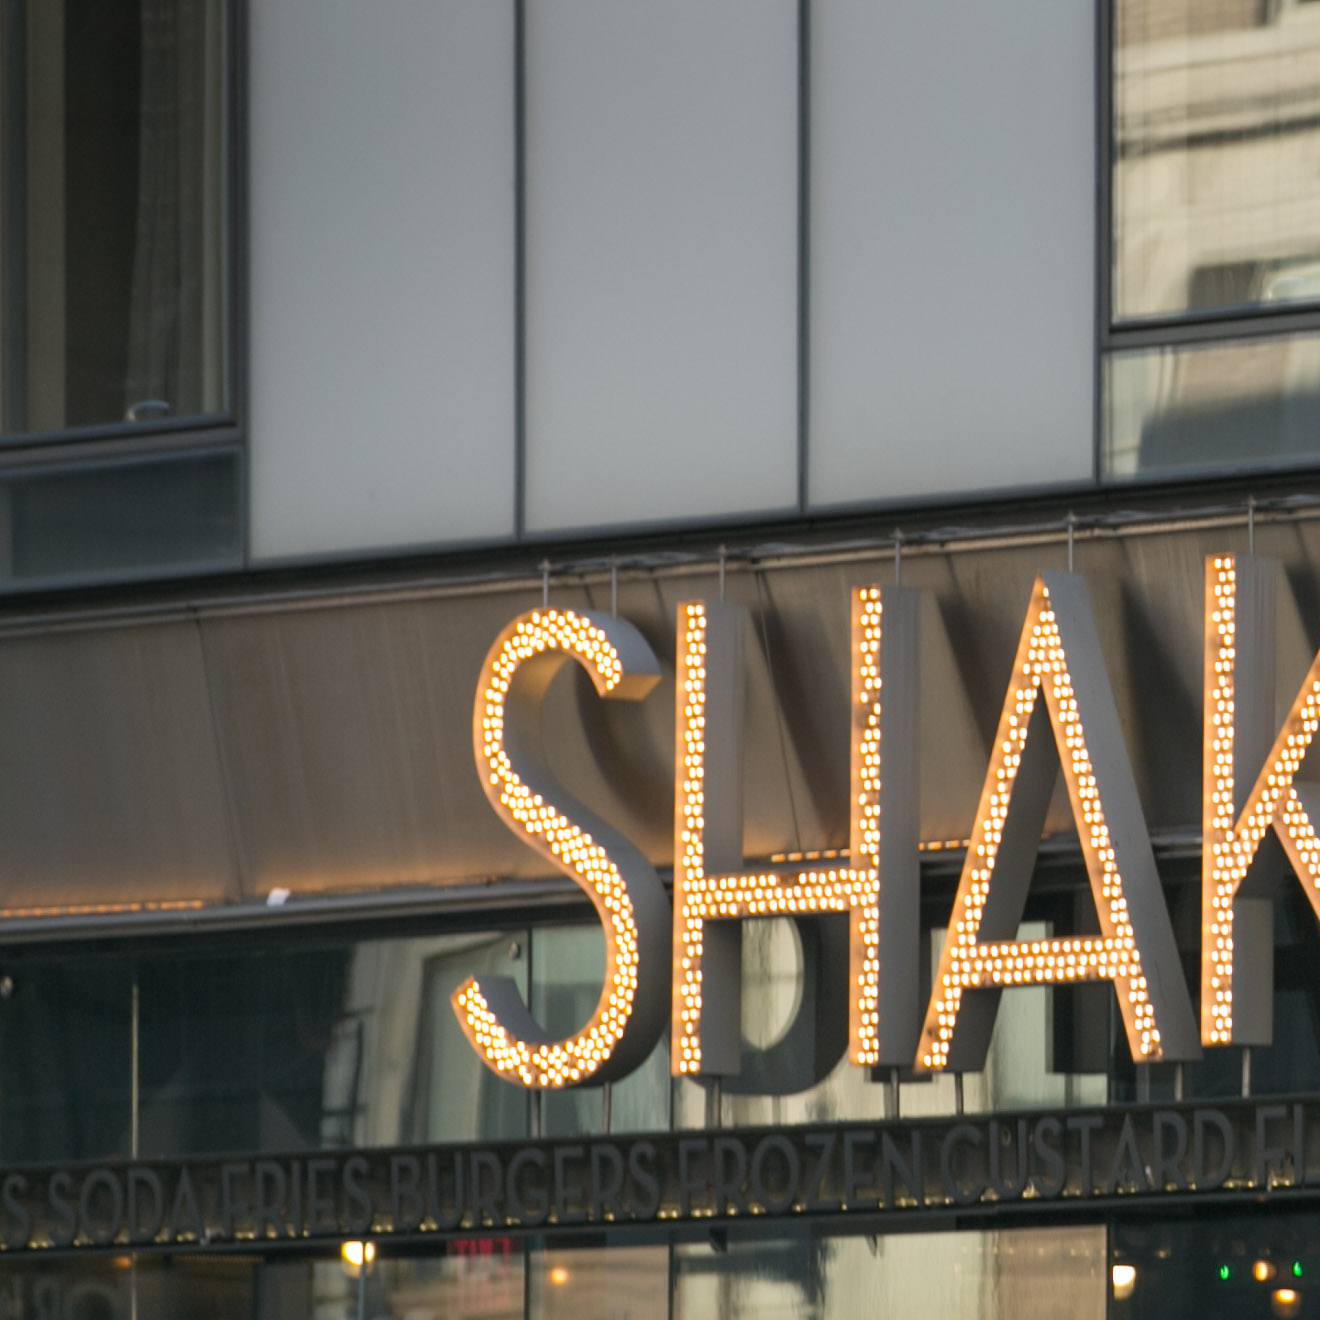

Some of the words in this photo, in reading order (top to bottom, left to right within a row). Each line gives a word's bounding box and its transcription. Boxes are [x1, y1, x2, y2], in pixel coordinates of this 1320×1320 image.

[46, 1163, 202, 1246] SODA
[221, 1155, 376, 1241] FRIES
[391, 1140, 661, 1232] BURGERS
[680, 1126, 921, 1221] FROZEN
[940, 1108, 1235, 1200] CUSTARD
